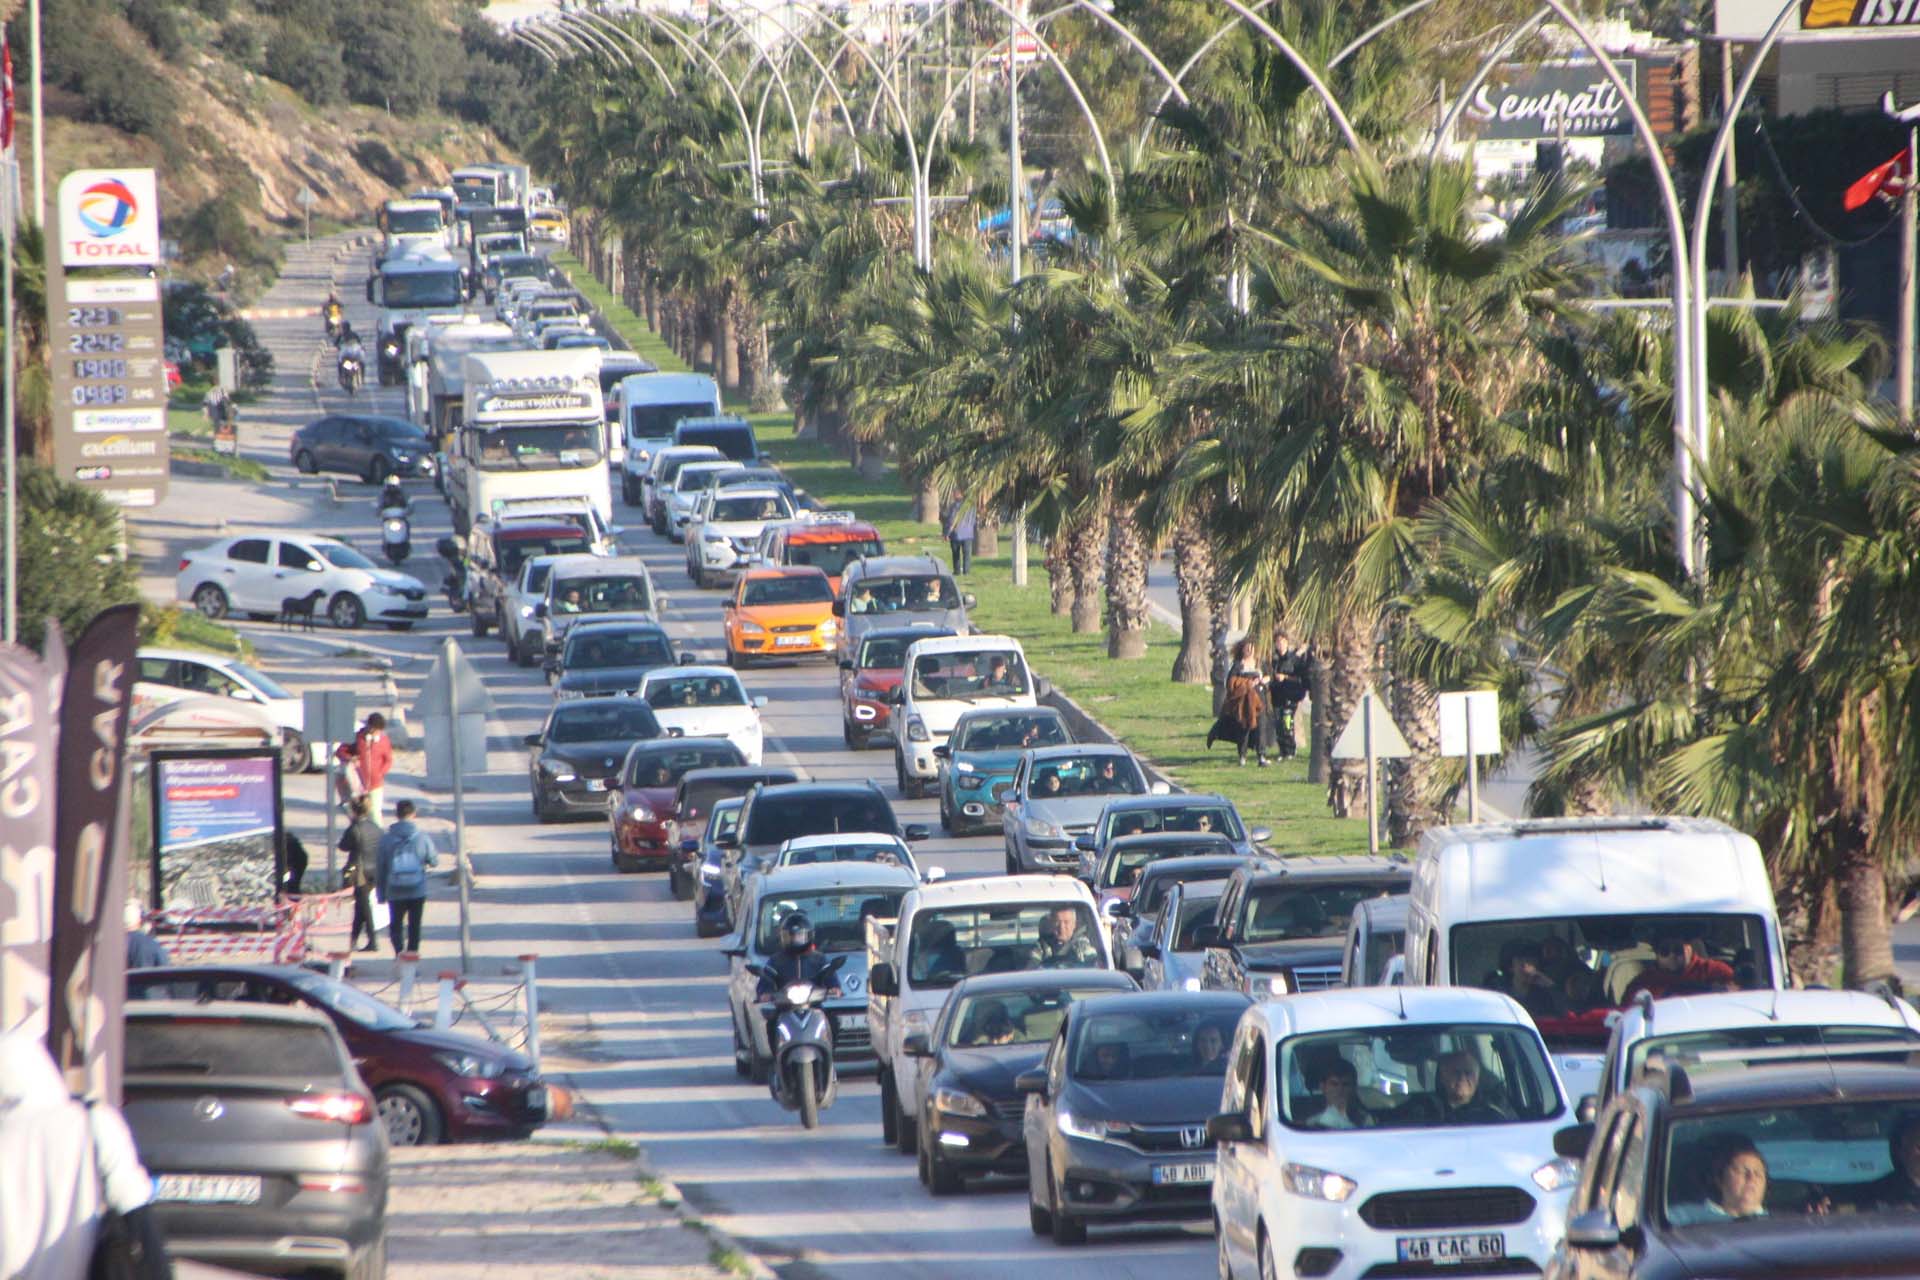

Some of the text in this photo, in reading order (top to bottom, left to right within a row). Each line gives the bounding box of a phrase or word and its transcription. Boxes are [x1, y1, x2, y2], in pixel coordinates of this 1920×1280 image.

[1467, 78, 1624, 134] Sempati
[69, 240, 150, 257] TOTAL
[89, 658, 125, 792] CAR
[1408, 1233, 1501, 1258] 48 CAC 60
